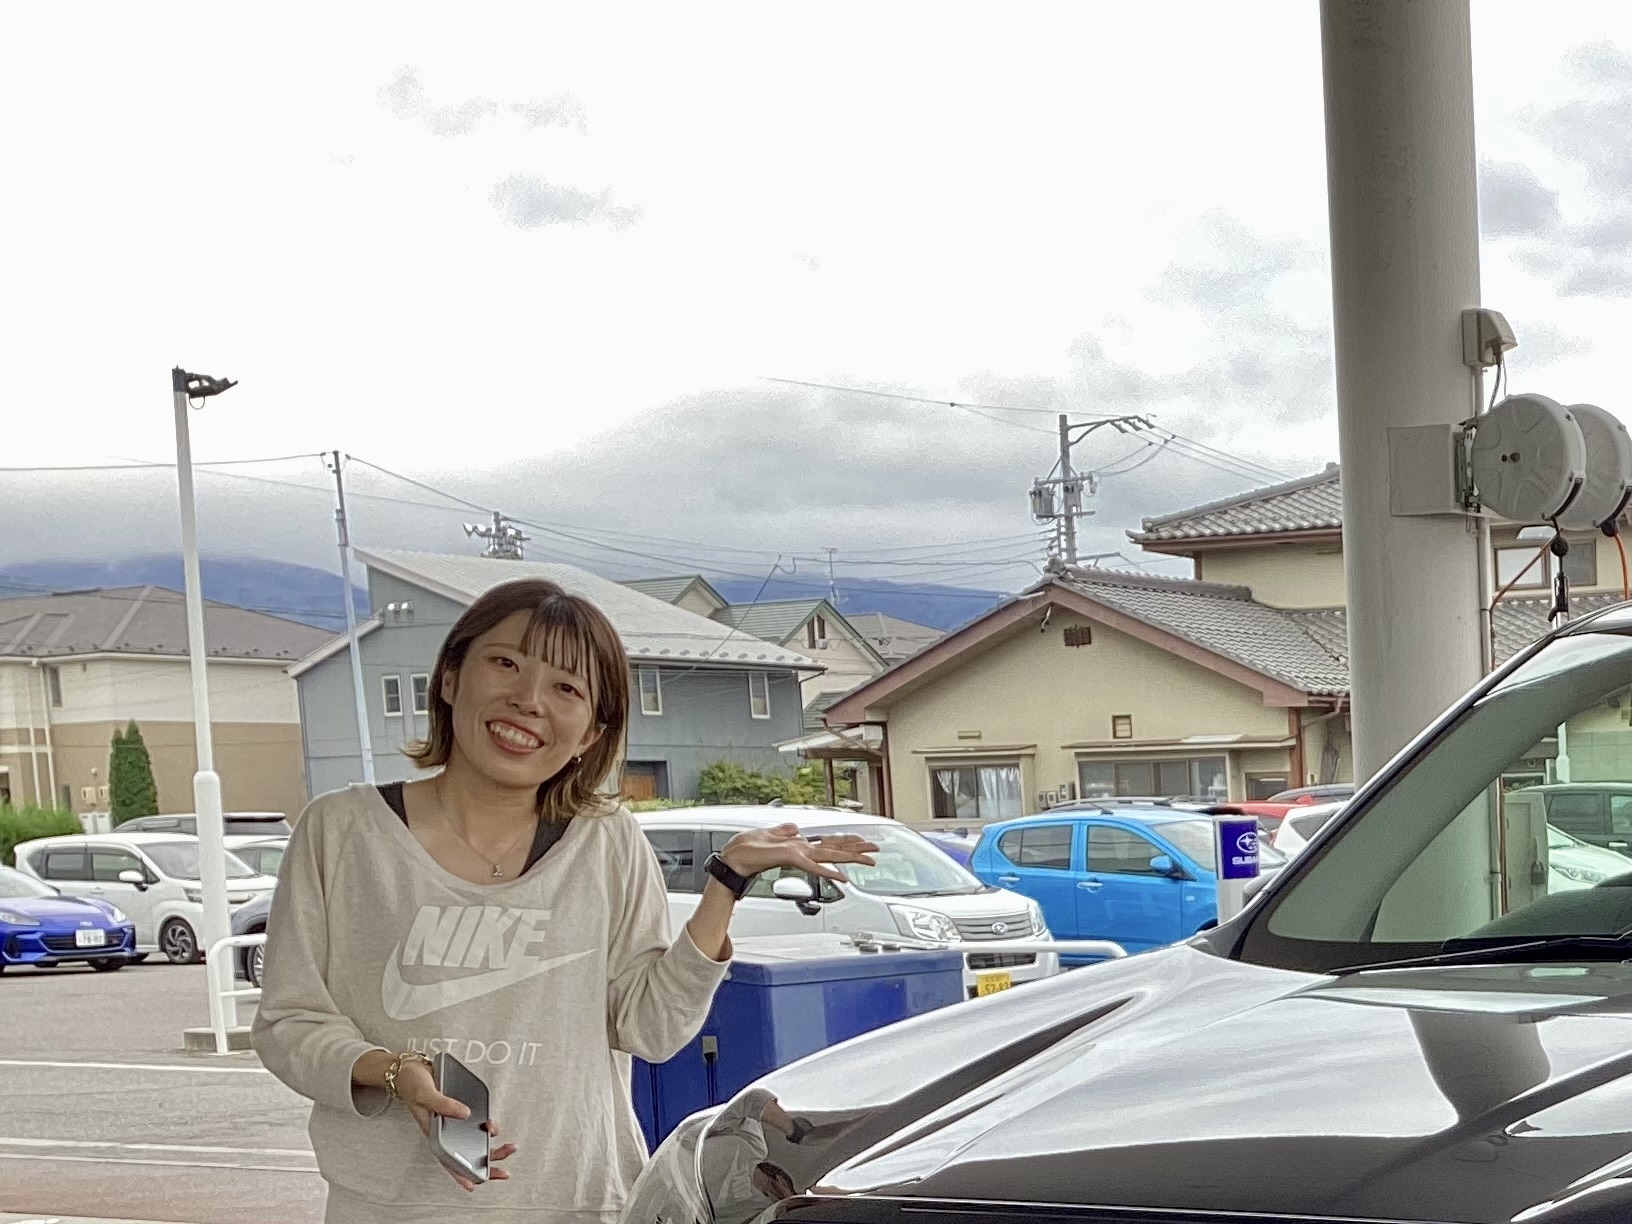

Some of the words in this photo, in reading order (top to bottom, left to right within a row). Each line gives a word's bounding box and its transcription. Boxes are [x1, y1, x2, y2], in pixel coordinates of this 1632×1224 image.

[402, 905, 553, 968] NIKE
[464, 1040, 511, 1064] DO
[518, 1041, 543, 1066] IT
